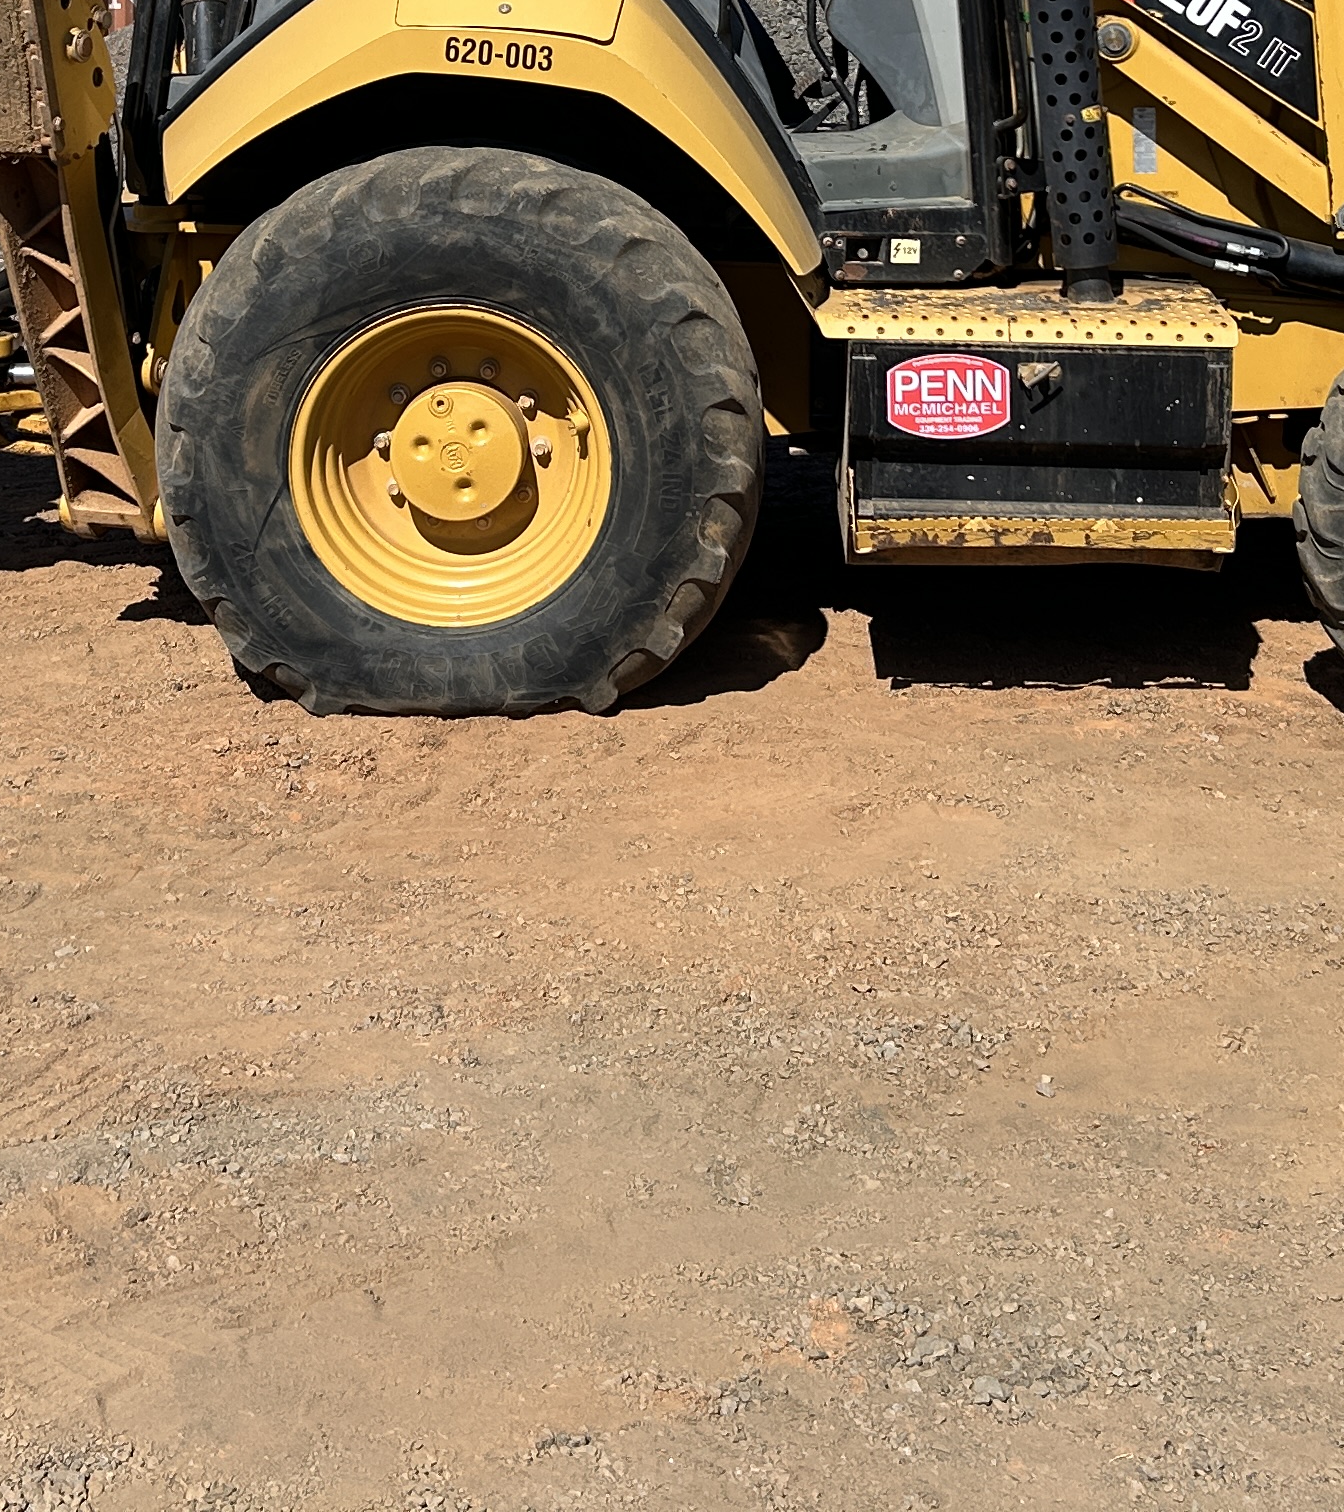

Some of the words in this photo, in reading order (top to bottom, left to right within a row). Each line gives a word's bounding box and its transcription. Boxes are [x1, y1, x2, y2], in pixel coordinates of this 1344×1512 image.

[445, 36, 553, 72] 620-003
[1256, 37, 1302, 77] IT
[894, 369, 1003, 403] PENN
[894, 402, 1003, 416] MCMICHAEL
